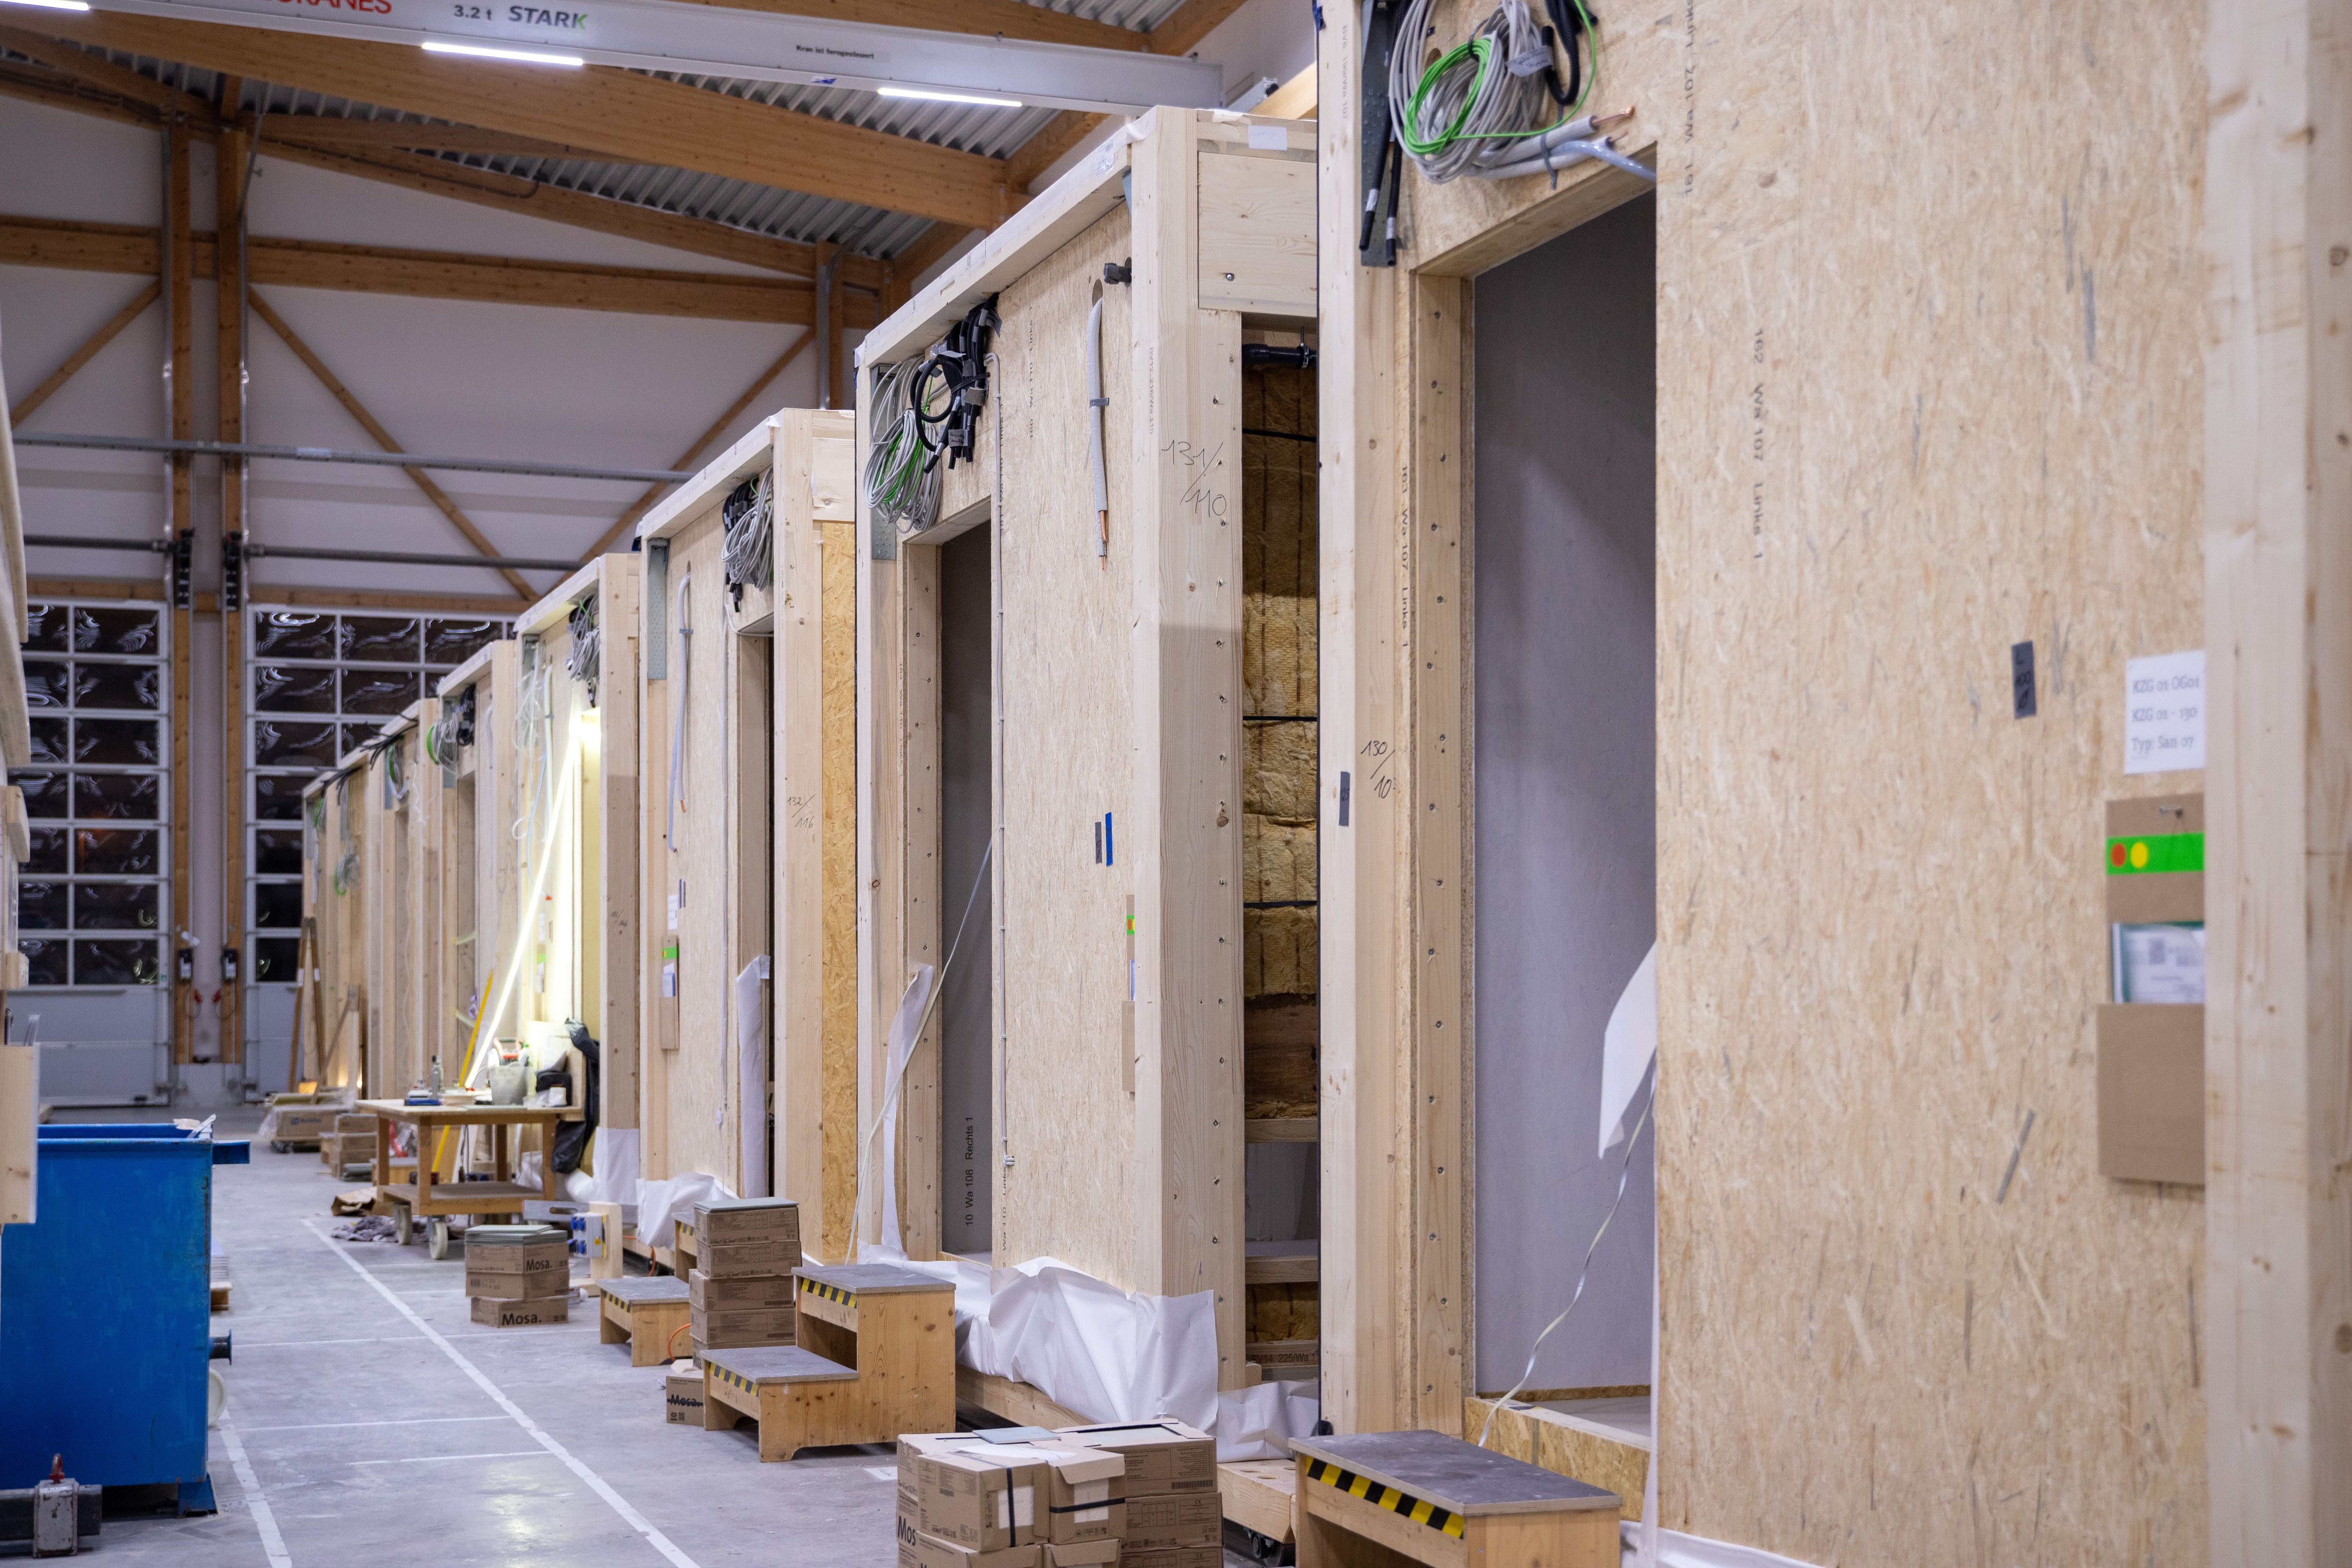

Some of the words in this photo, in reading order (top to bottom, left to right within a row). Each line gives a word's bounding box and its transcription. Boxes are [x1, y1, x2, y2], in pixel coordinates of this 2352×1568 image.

[453, 5, 481, 19] 3.2
[487, 9, 492, 21] t
[509, 6, 588, 30] STARK
[1754, 328, 1763, 364] 162
[1029, 388, 1034, 407] Wa
[1754, 427, 1763, 461] 107
[1754, 483, 1763, 536] Links
[1401, 508, 1408, 536] Wa
[965, 1125, 974, 1160] Rechts
[965, 1168, 974, 1188] 108
[965, 1191, 974, 1208] Wa
[965, 1214, 974, 1227] 10
[526, 1259, 553, 1272] Mosa.
[502, 1313, 542, 1326] Mosa.
